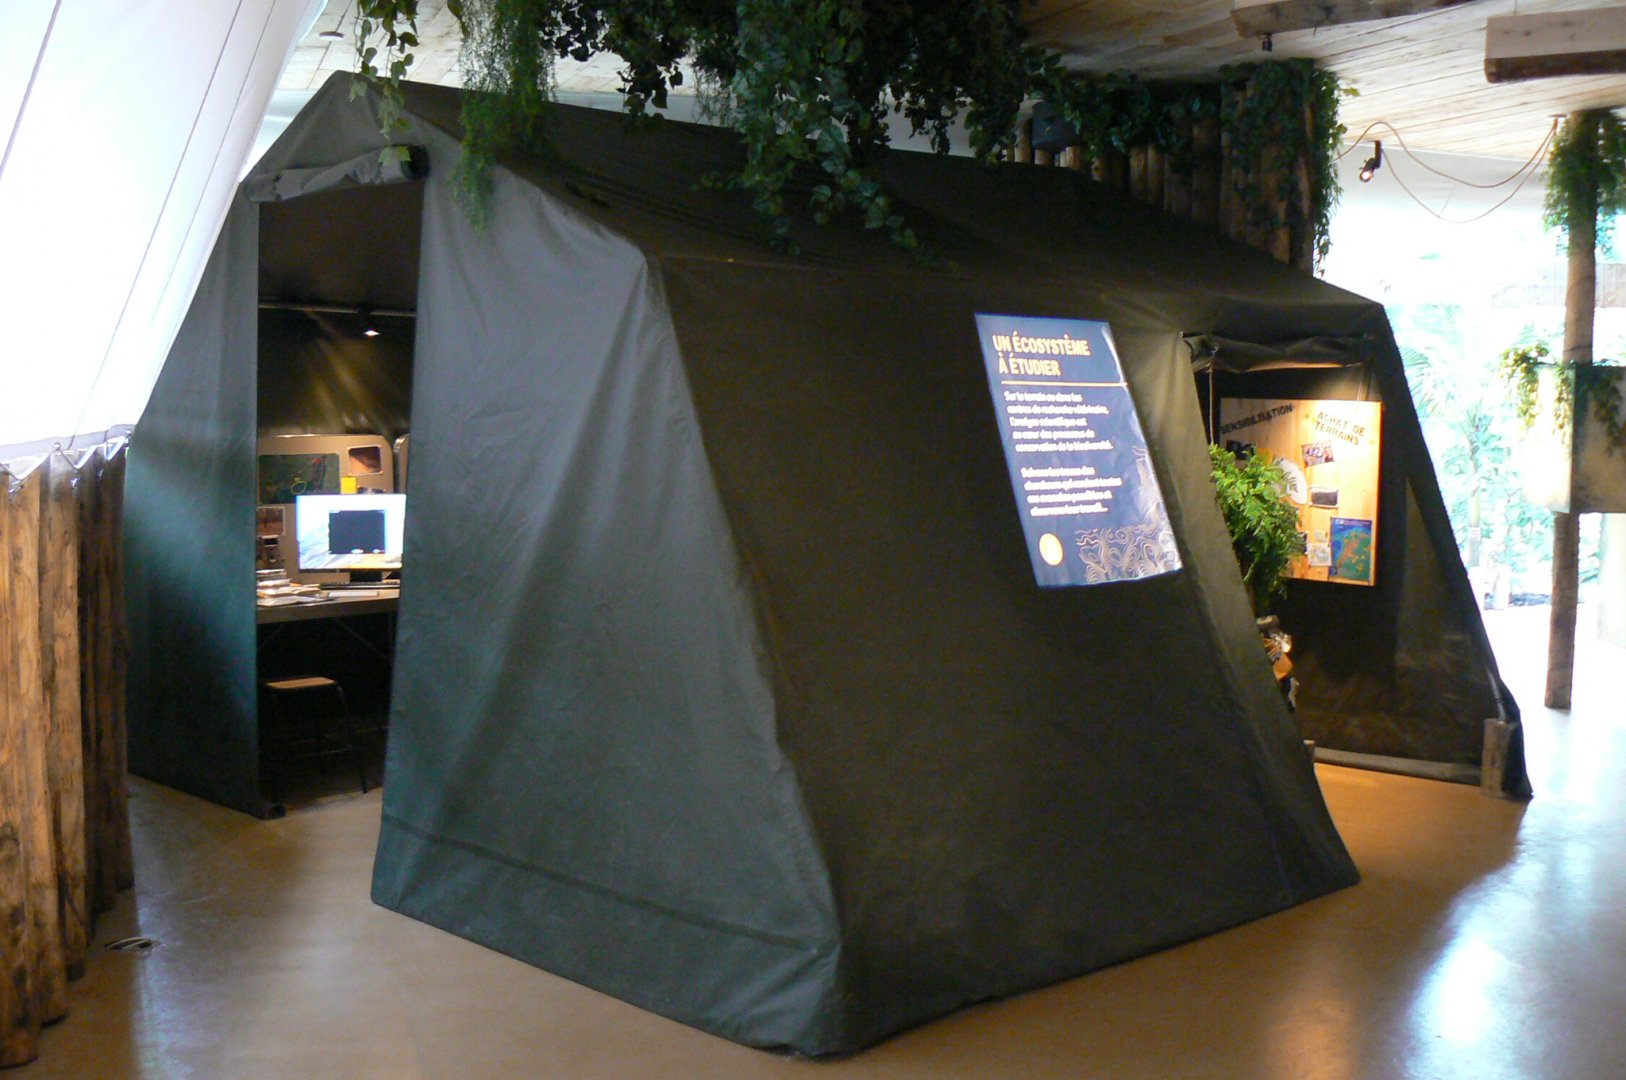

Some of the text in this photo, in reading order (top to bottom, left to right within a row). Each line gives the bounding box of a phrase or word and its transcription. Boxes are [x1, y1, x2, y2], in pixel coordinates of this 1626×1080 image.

[992, 331, 1091, 356] UN ÉCOSYSTÈME
[998, 352, 1062, 376] À ÉTUDIER
[1220, 404, 1294, 434] SENSIBILISATION
[1317, 411, 1366, 437] ACHAT DE
[1315, 421, 1359, 445] TERRAINS
